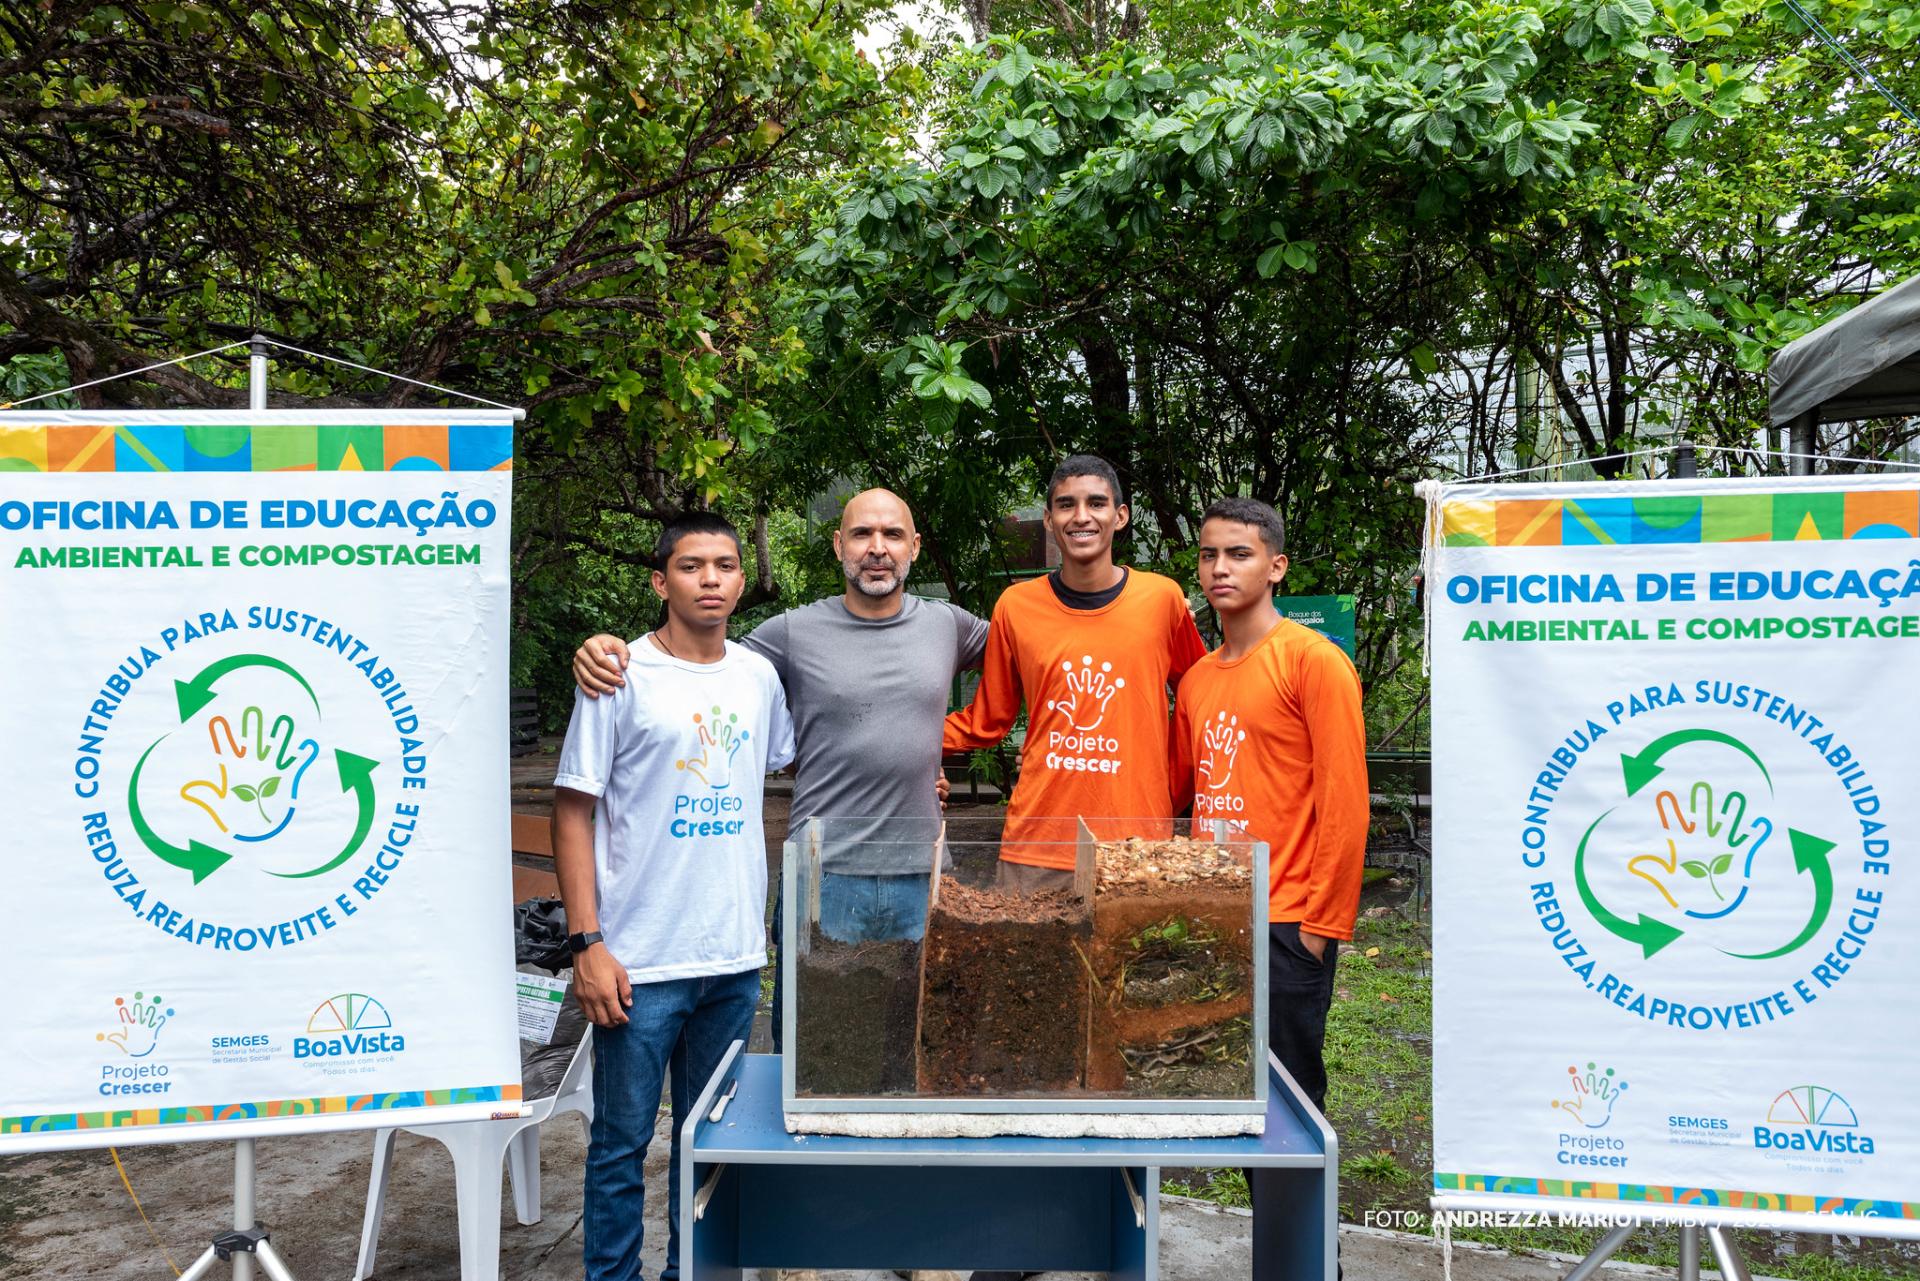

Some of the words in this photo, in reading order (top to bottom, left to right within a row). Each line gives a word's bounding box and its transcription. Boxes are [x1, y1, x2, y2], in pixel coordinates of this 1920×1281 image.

[0, 500, 180, 530] OFICINA
[190, 501, 248, 529] DE
[261, 491, 497, 536] EDUCAÇÃO
[13, 546, 202, 568] AMBIENTAL
[212, 546, 230, 566] E
[239, 543, 481, 566] COMPOSTAGEM
[1446, 574, 1625, 605] OFICINA
[1637, 573, 1696, 602] DE
[1462, 619, 1649, 642] AMBIENTAL
[1658, 618, 1677, 641] E
[1686, 615, 1920, 640] COMPOSTAGE
[75, 646, 162, 798] CONTRIBUA
[161, 608, 238, 651] PARA
[247, 606, 426, 789] SUSTENTABILIDADE
[1049, 732, 1119, 754] Projeto
[1046, 752, 1121, 774] Crescer
[1522, 719, 1608, 868] CONTRIBUA
[1606, 682, 1685, 724] PARA
[1695, 680, 1890, 875] SUSTENTABILIDADE
[675, 791, 742, 815] Projeo
[1195, 792, 1244, 814] Pojeto
[670, 818, 744, 838] Crescr
[146, 901, 336, 951] REAPROVEITE
[335, 893, 359, 916] E
[352, 803, 420, 900] RECICLE
[1596, 973, 1794, 1030] REAPROVEITE
[1793, 979, 1817, 1004] E
[1811, 888, 1883, 988] RECICLE
[212, 1035, 269, 1048] SEMGES
[249, 1046, 282, 1055] Municipal
[249, 1054, 271, 1062] Social
[375, 1055, 395, 1063] você
[102, 1063, 169, 1081] Projeto
[99, 1080, 171, 1096] Crescer
[1668, 1116, 1728, 1130] SEMGES
[1559, 1133, 1624, 1152] Projeto
[1557, 1151, 1628, 1168] Crescer
